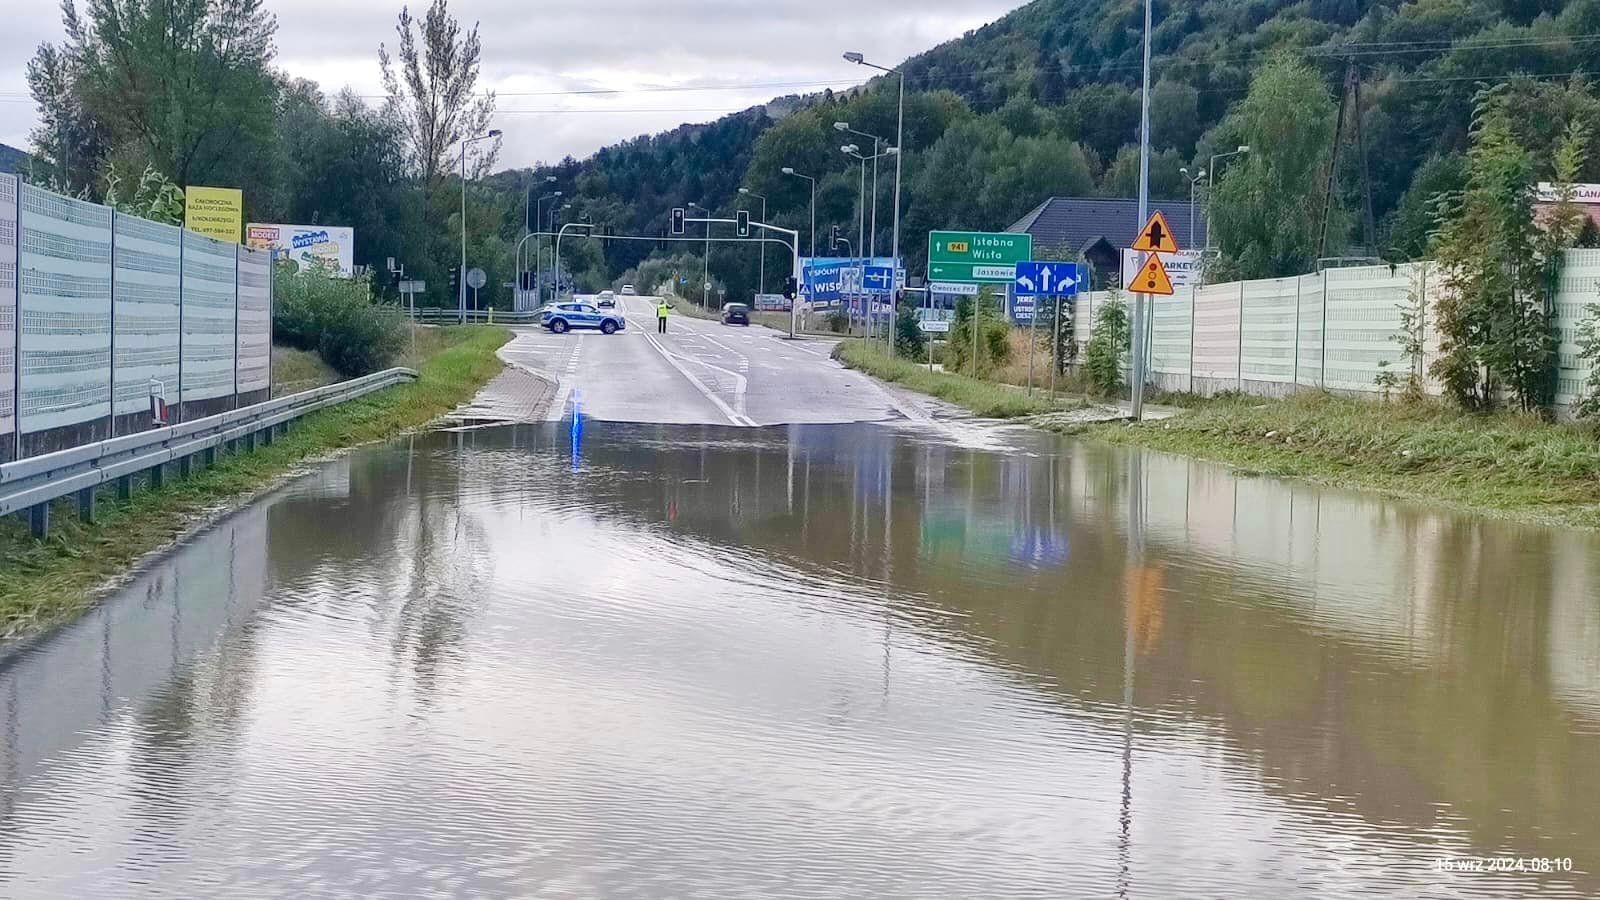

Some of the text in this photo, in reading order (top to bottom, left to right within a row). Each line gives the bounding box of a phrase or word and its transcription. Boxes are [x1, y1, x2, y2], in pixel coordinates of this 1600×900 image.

[293, 235, 329, 248] WYSTAWA
[972, 236, 1014, 247] Istebna
[950, 243, 965, 251] 941
[972, 250, 1002, 259] Wisła
[977, 268, 1014, 276] Jaszowie
[1016, 296, 1034, 304] JERZ
